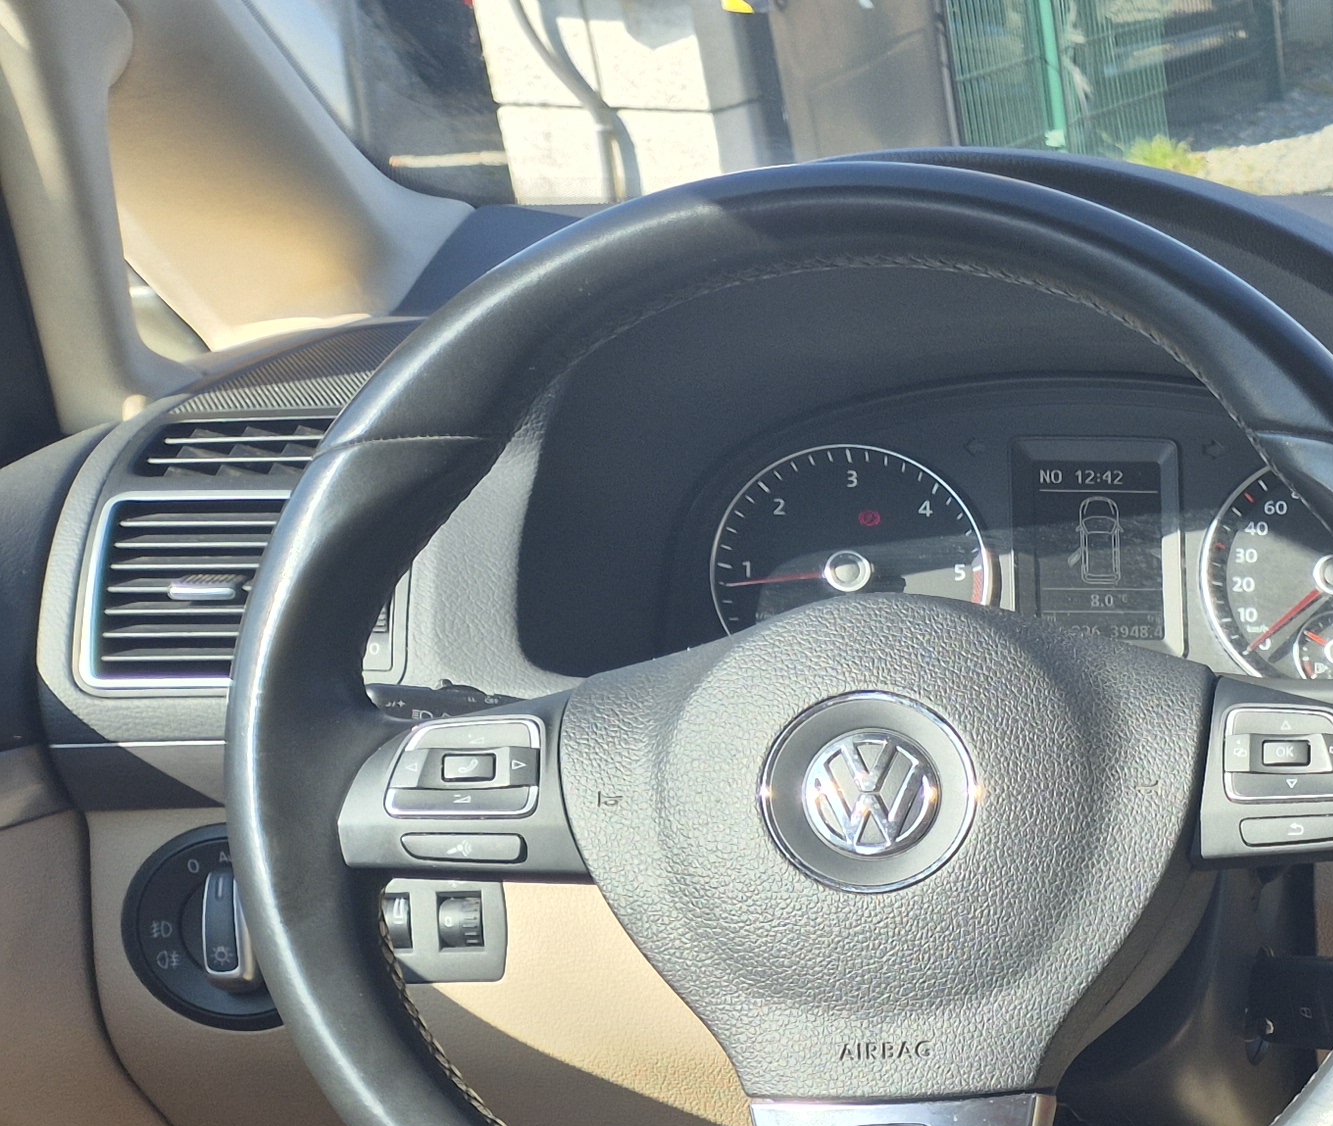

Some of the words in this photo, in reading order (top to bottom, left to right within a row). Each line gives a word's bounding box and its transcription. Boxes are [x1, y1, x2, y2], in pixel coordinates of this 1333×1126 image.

[846, 470, 859, 488] 3
[1039, 469, 1063, 485] NO
[1075, 469, 1123, 485] 12:42
[772, 498, 786, 516] 2
[917, 500, 933, 517] 4
[1263, 500, 1288, 516] 60
[1243, 521, 1269, 536] 40
[1234, 548, 1258, 564] 30
[741, 560, 751, 578] 1
[953, 563, 967, 581] 5
[1231, 577, 1256, 593] 20
[1090, 593, 1114, 608] 8.0
[1236, 607, 1258, 623] 10
[1275, 744, 1295, 759] OK
[839, 1040, 932, 1062] AIRBAG
